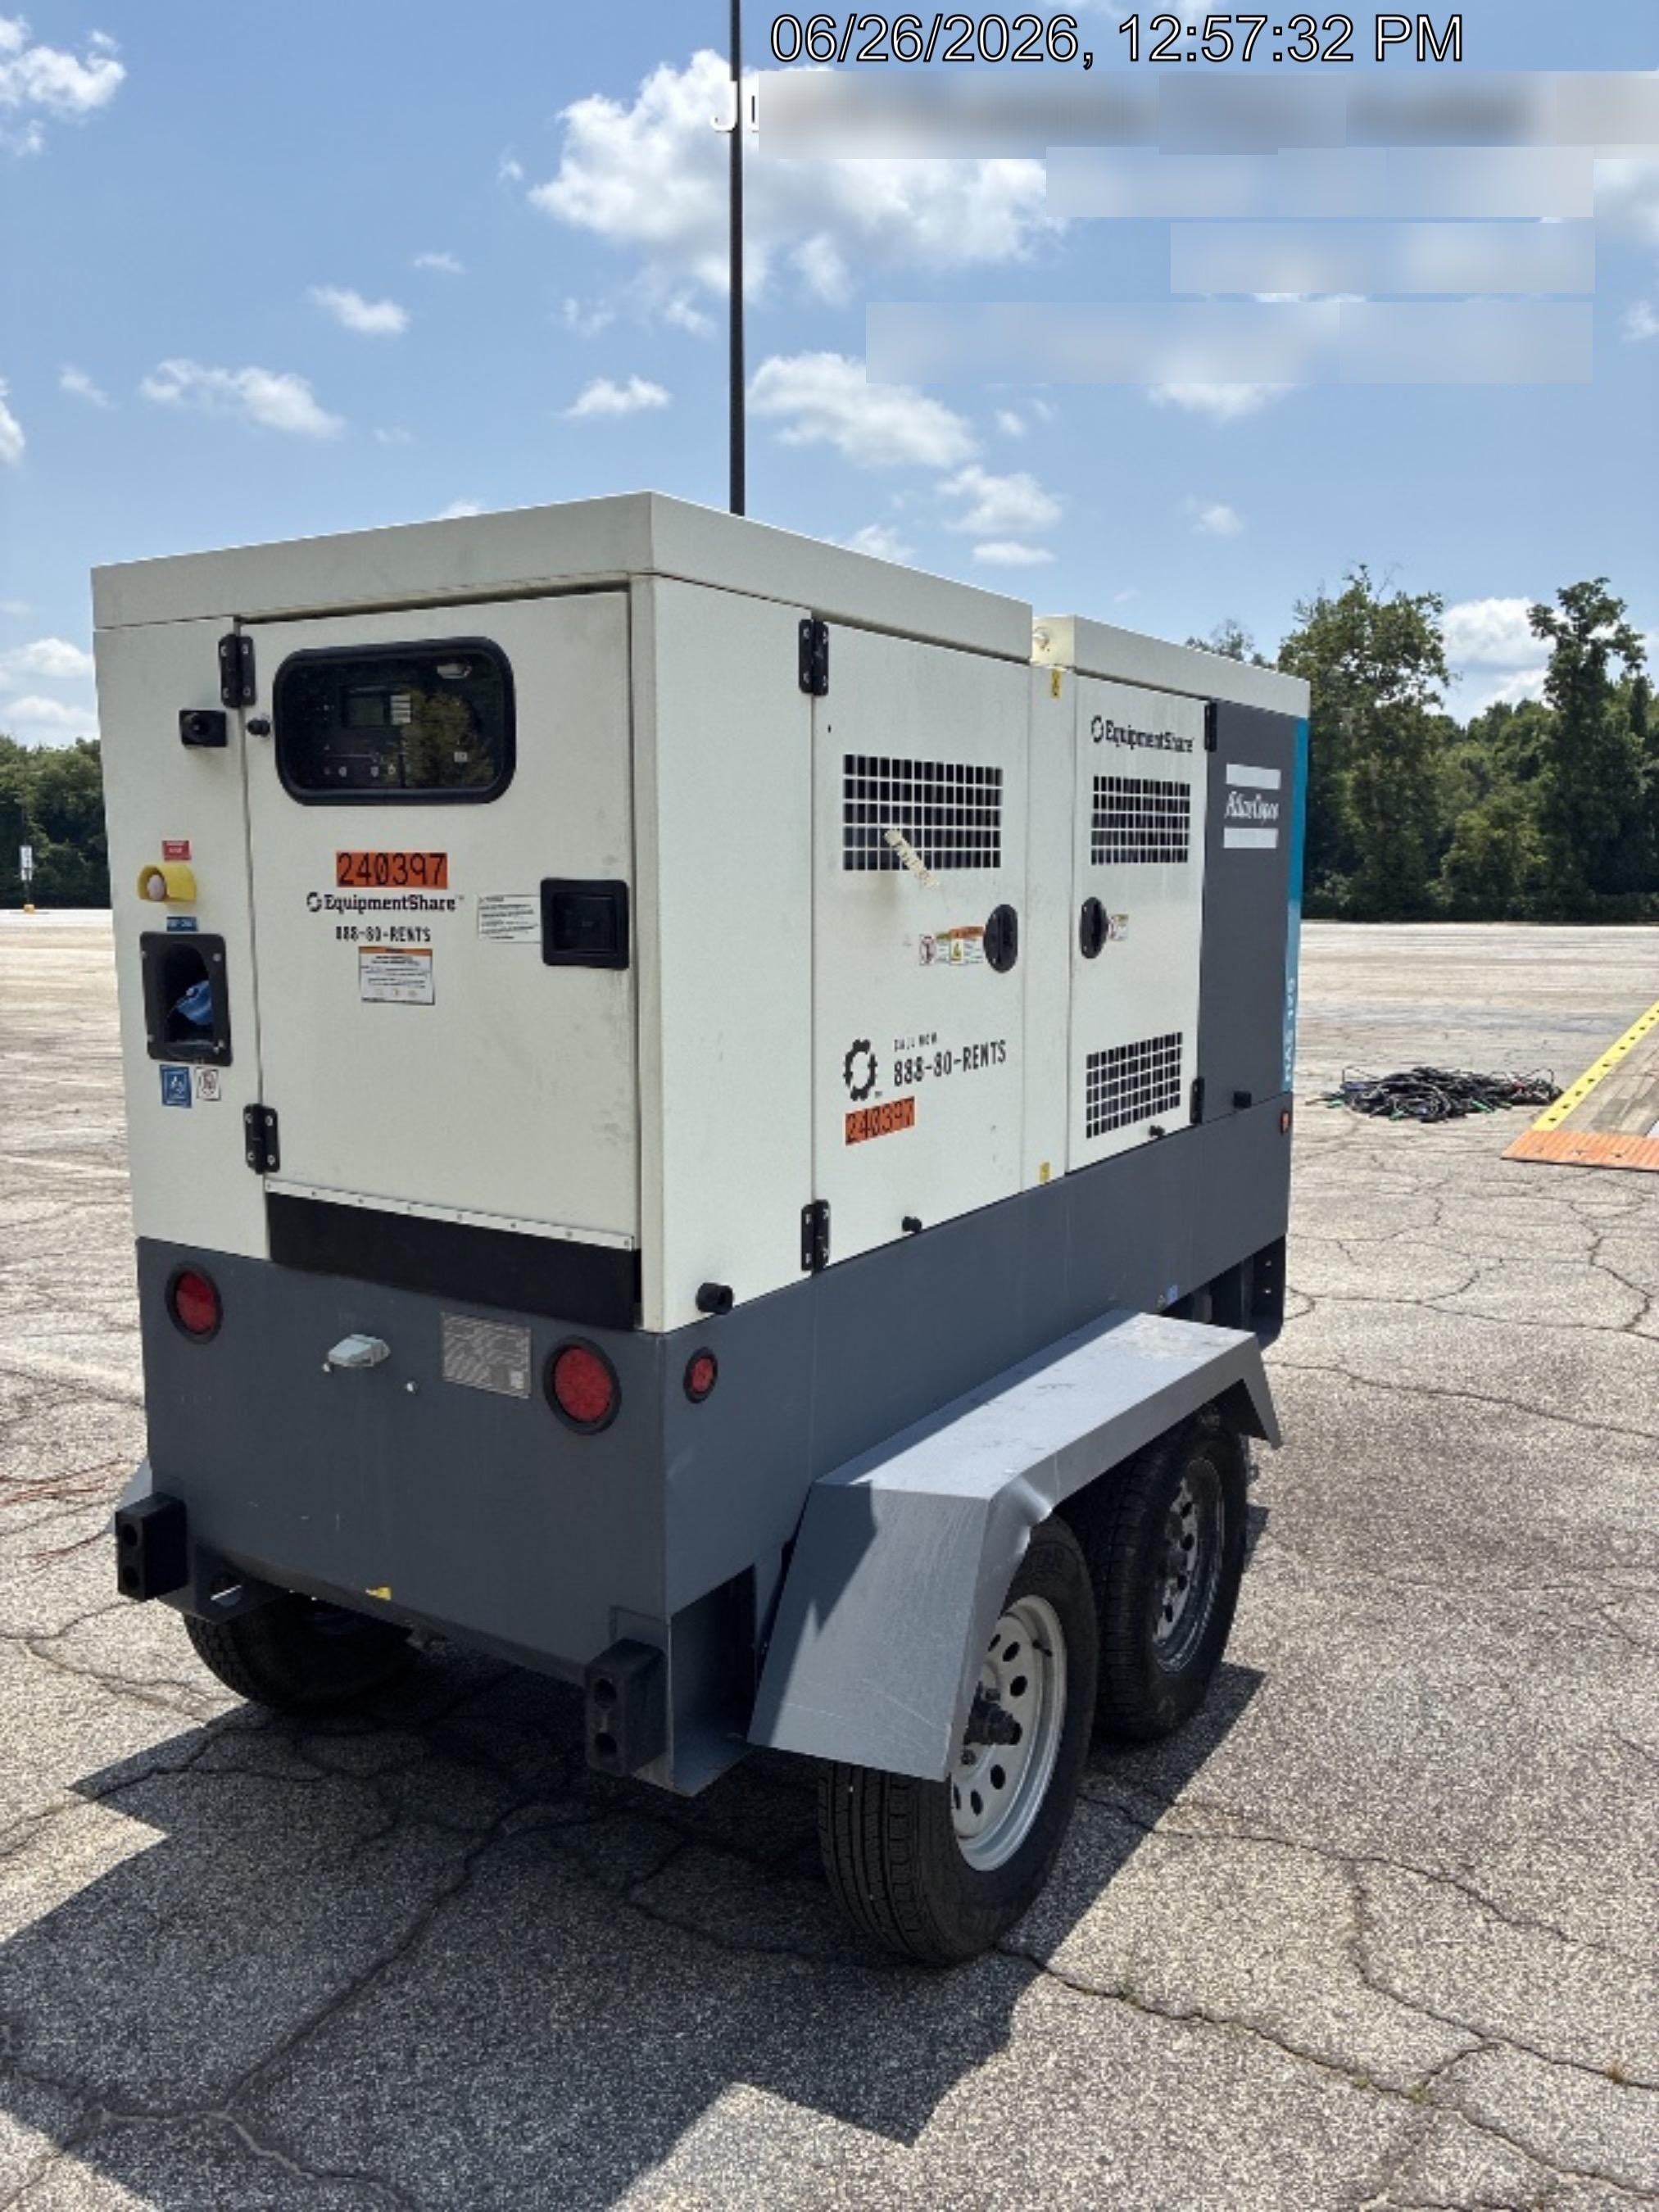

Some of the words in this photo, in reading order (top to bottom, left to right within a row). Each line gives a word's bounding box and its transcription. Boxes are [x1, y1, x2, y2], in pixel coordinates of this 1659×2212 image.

[1106, 719, 1193, 753] EquipmentShare
[337, 852, 446, 886] 240397
[323, 893, 456, 914] EquipmentShare
[336, 926, 431, 942] 888-80-RENTS
[894, 1040, 1006, 1086] 888-80-RENTS
[845, 1098, 913, 1145] 240397
